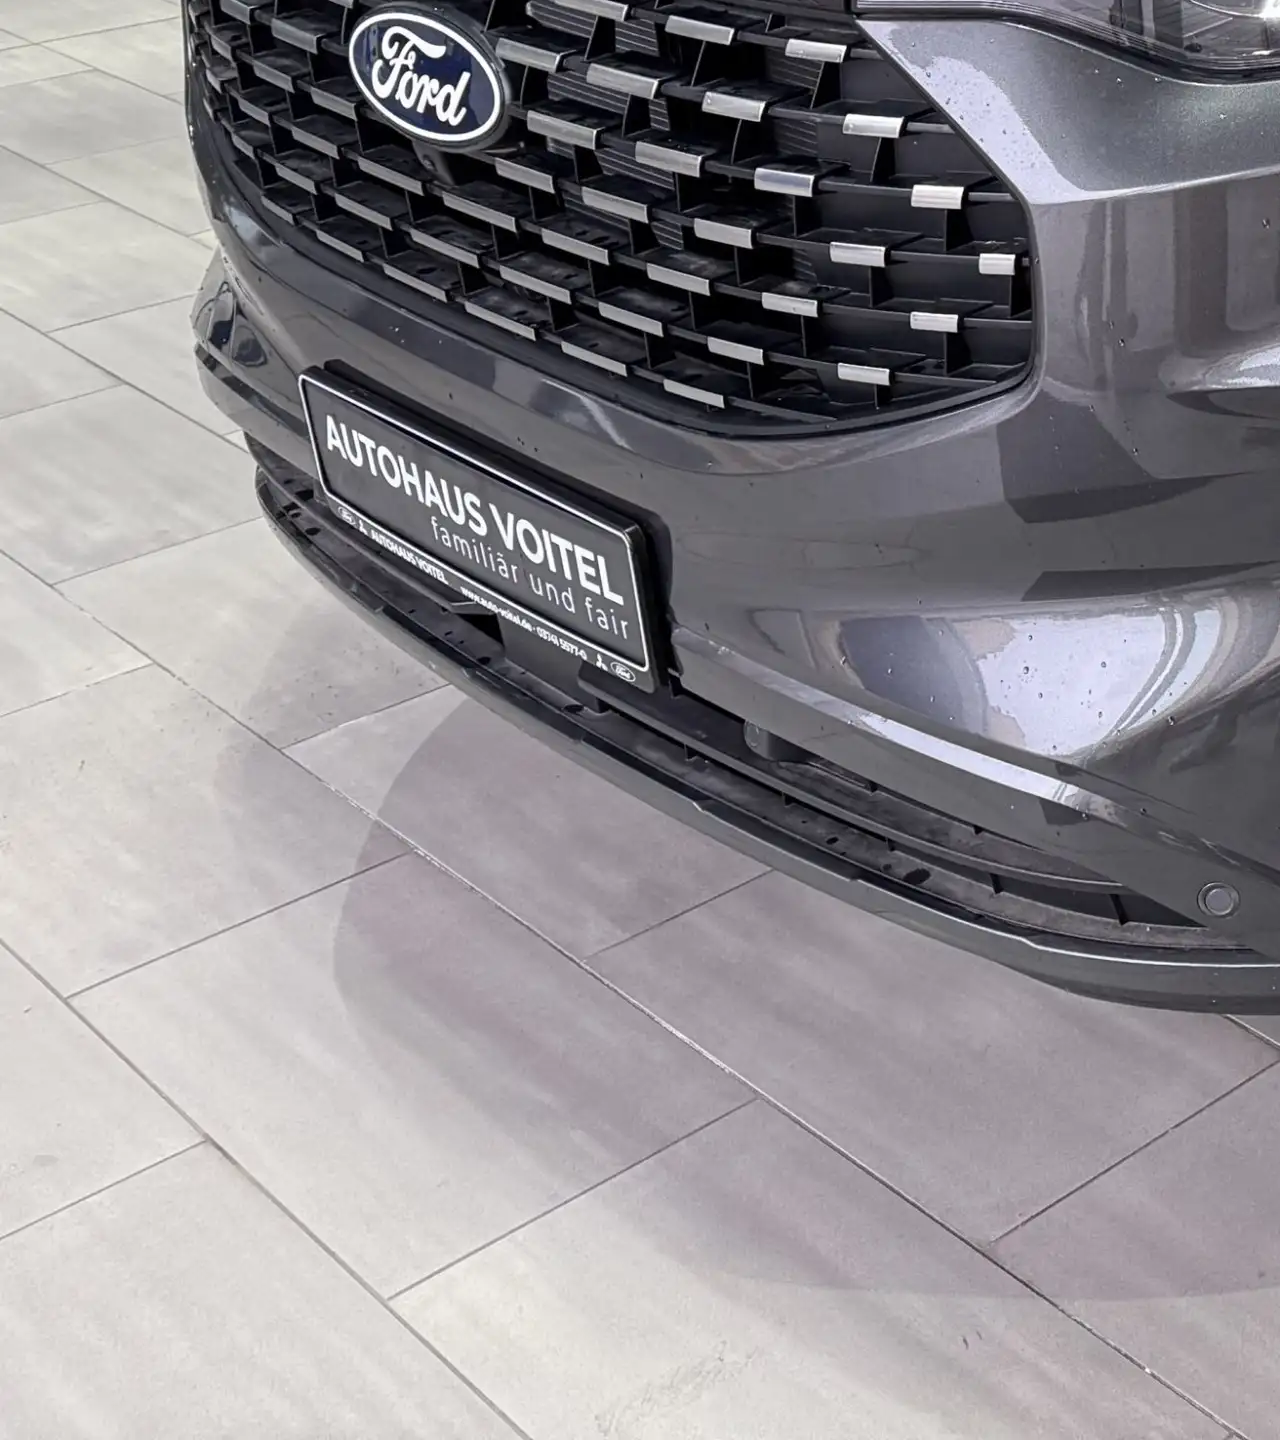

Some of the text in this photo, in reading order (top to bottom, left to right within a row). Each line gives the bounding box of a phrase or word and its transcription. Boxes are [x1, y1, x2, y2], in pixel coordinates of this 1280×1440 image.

[371, 25, 471, 126] Ford
[326, 414, 625, 606] AUTOHAUS VOITEL
[371, 529, 416, 566] AUTOHAUS
[431, 516, 629, 640] familiär und fair
